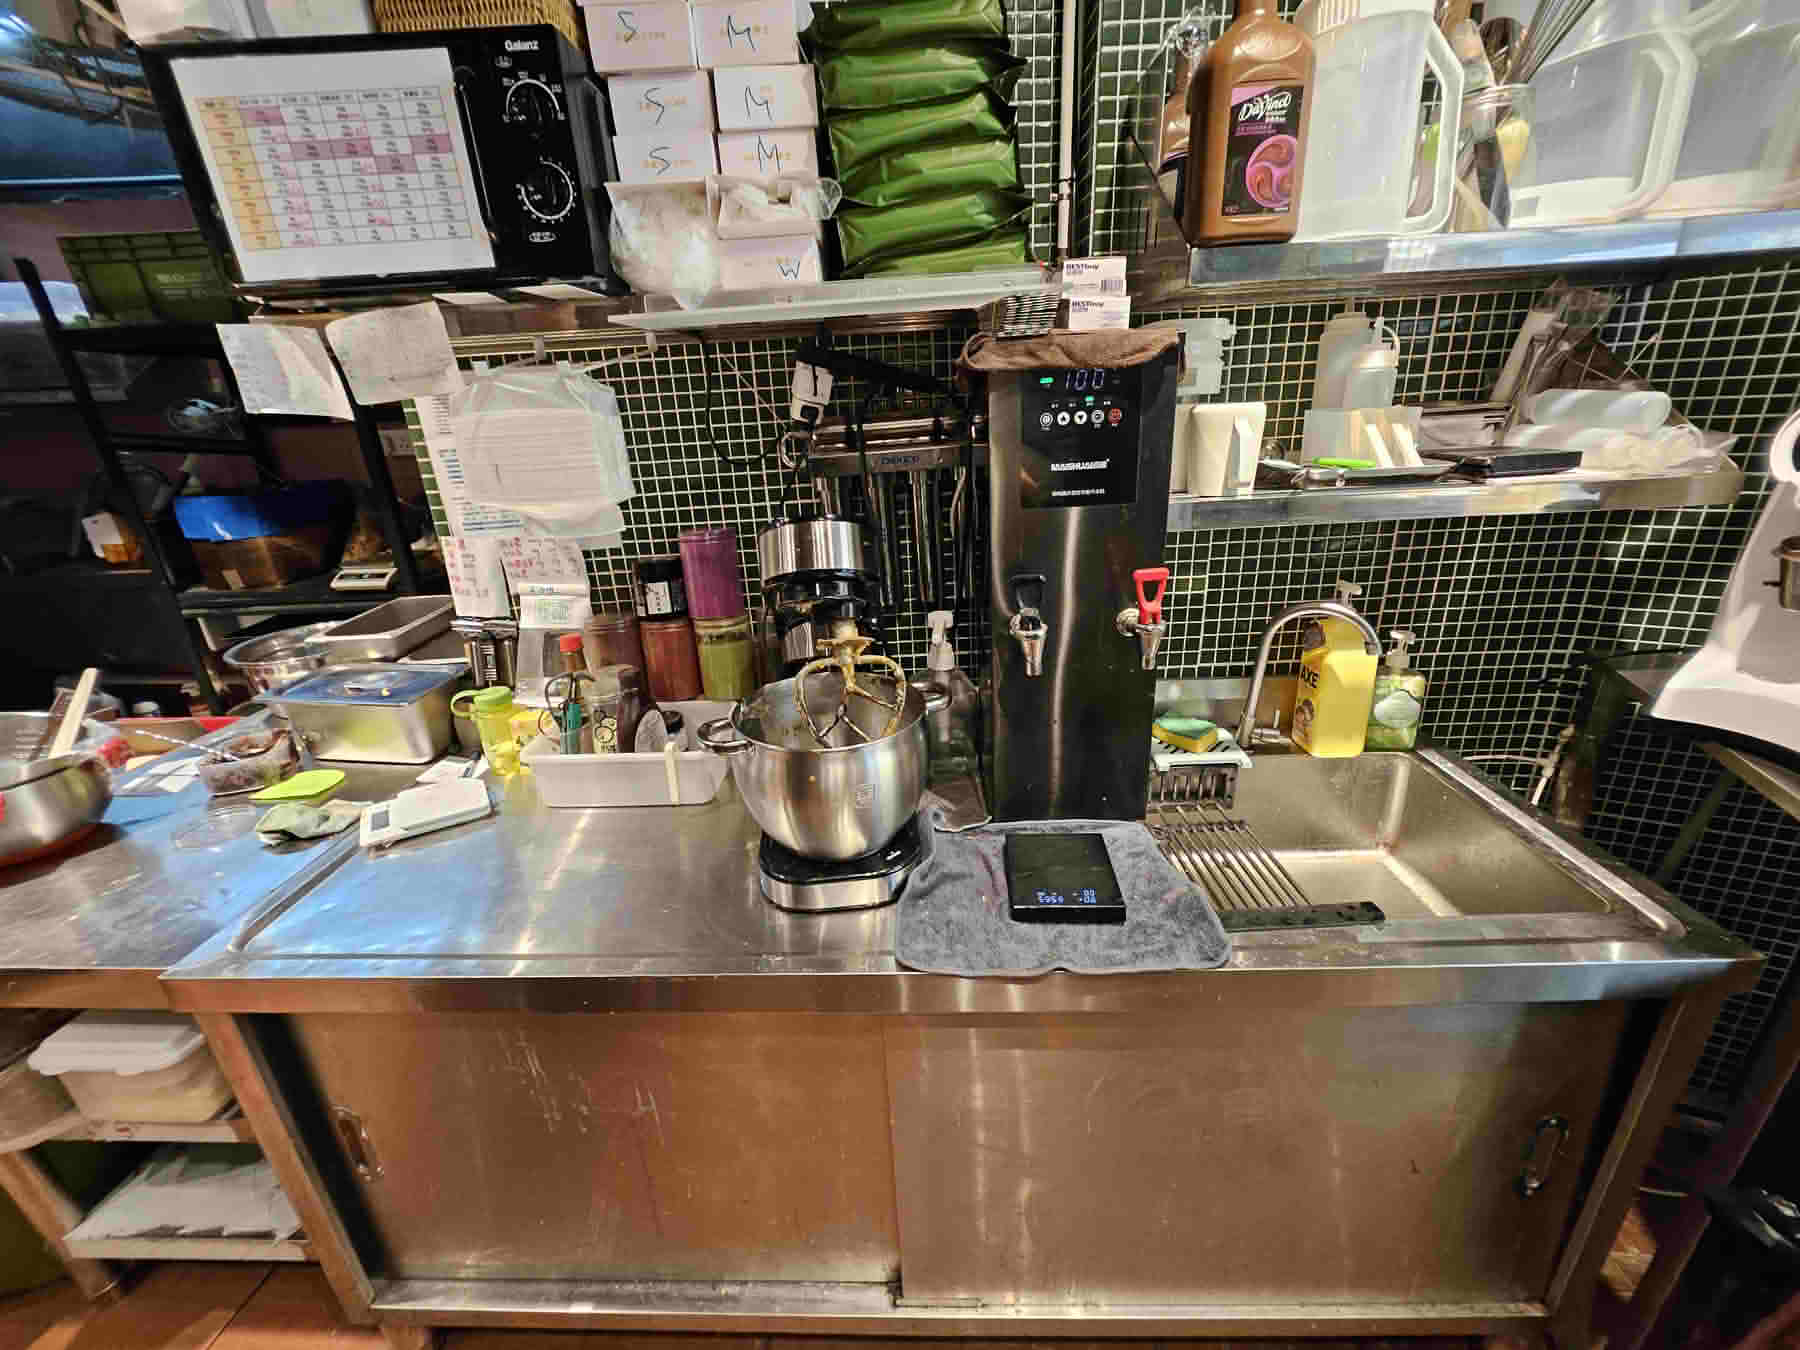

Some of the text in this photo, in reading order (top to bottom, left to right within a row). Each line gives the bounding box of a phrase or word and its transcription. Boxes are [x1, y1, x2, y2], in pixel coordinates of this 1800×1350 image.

[617, 10, 637, 42] S
[643, 87, 665, 125] S
[648, 146, 672, 175] S
